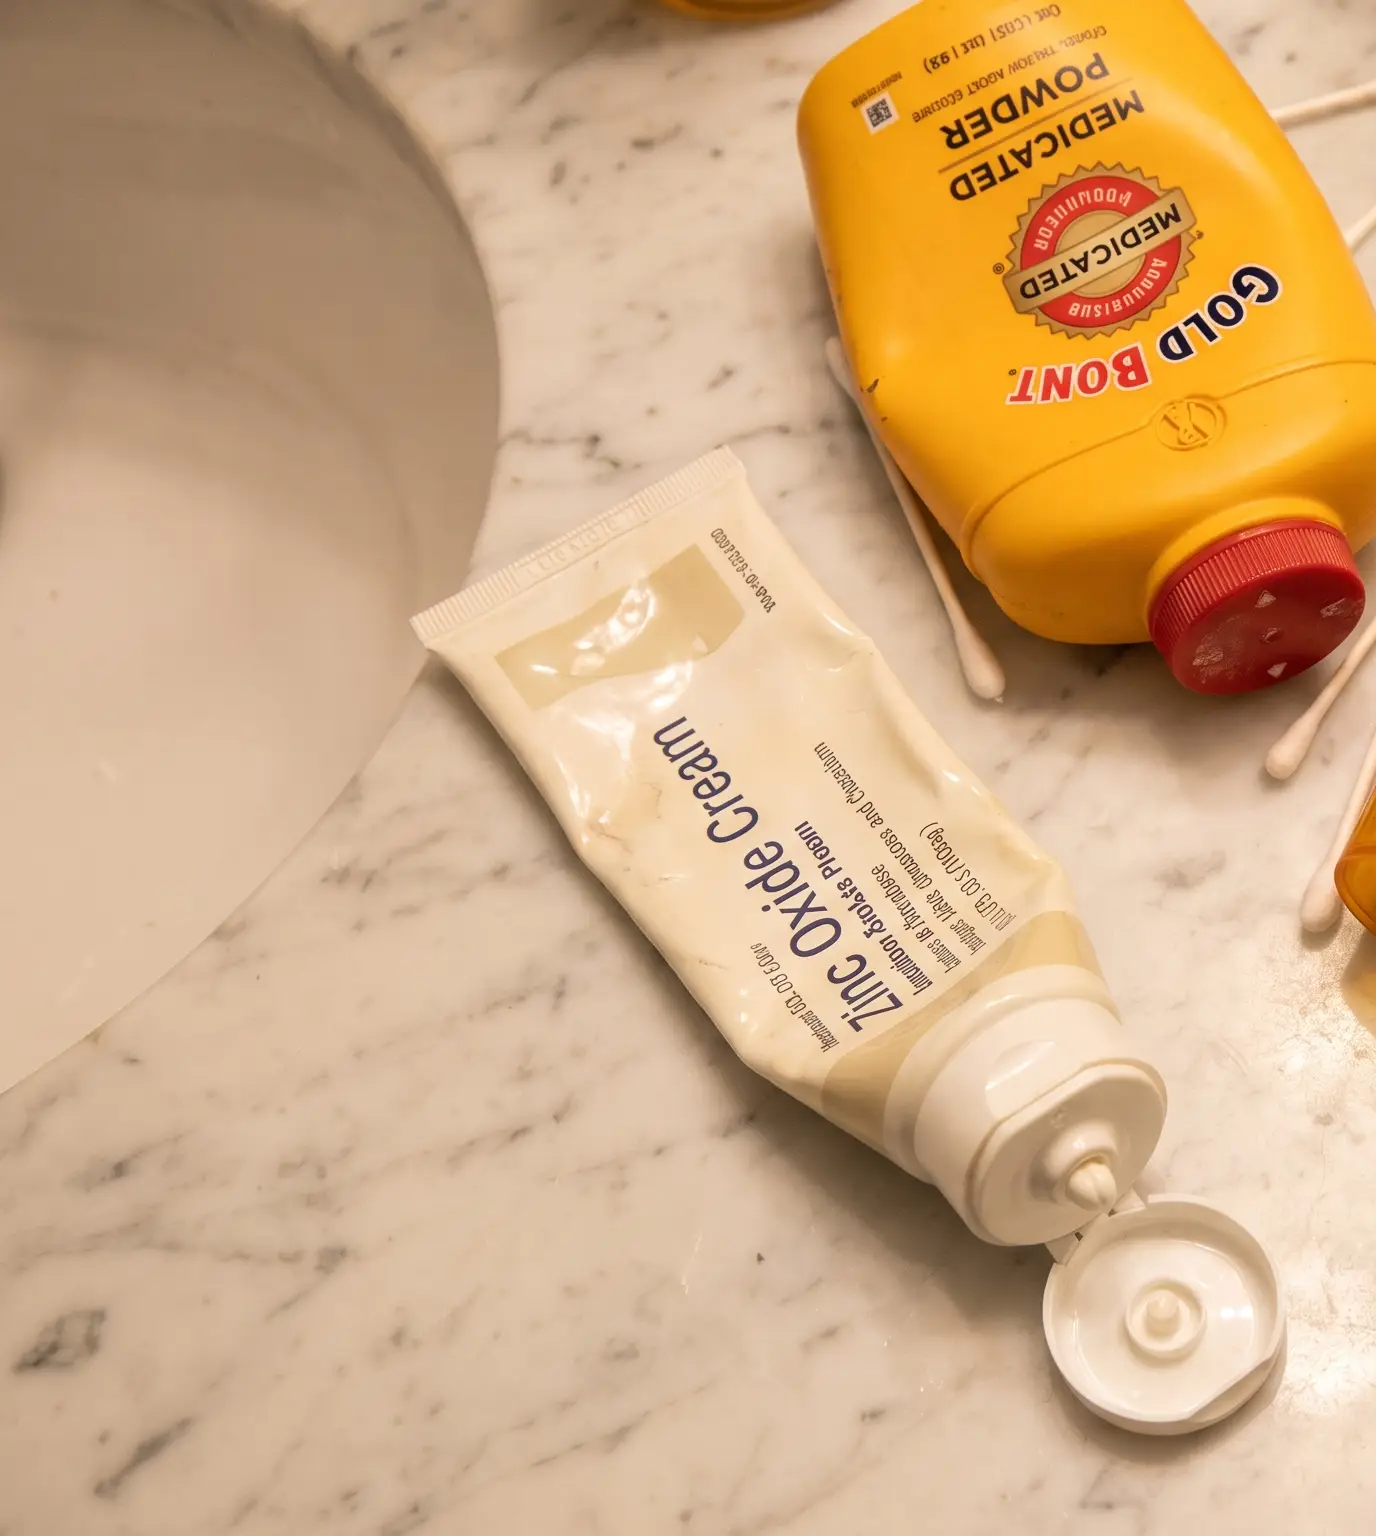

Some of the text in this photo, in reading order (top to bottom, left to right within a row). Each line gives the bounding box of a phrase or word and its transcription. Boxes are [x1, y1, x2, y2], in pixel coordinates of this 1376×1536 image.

[939, 53, 1107, 150] POWDER
[949, 98, 1144, 201] MEDICATED
[1019, 202, 1182, 300] MEDICATED
[1157, 264, 1281, 363] GOLD
[1009, 347, 1149, 403] BONT
[653, 716, 759, 844] Cream
[855, 801, 884, 829] and
[743, 840, 842, 958] Oxide
[826, 953, 904, 1033] Zinc
